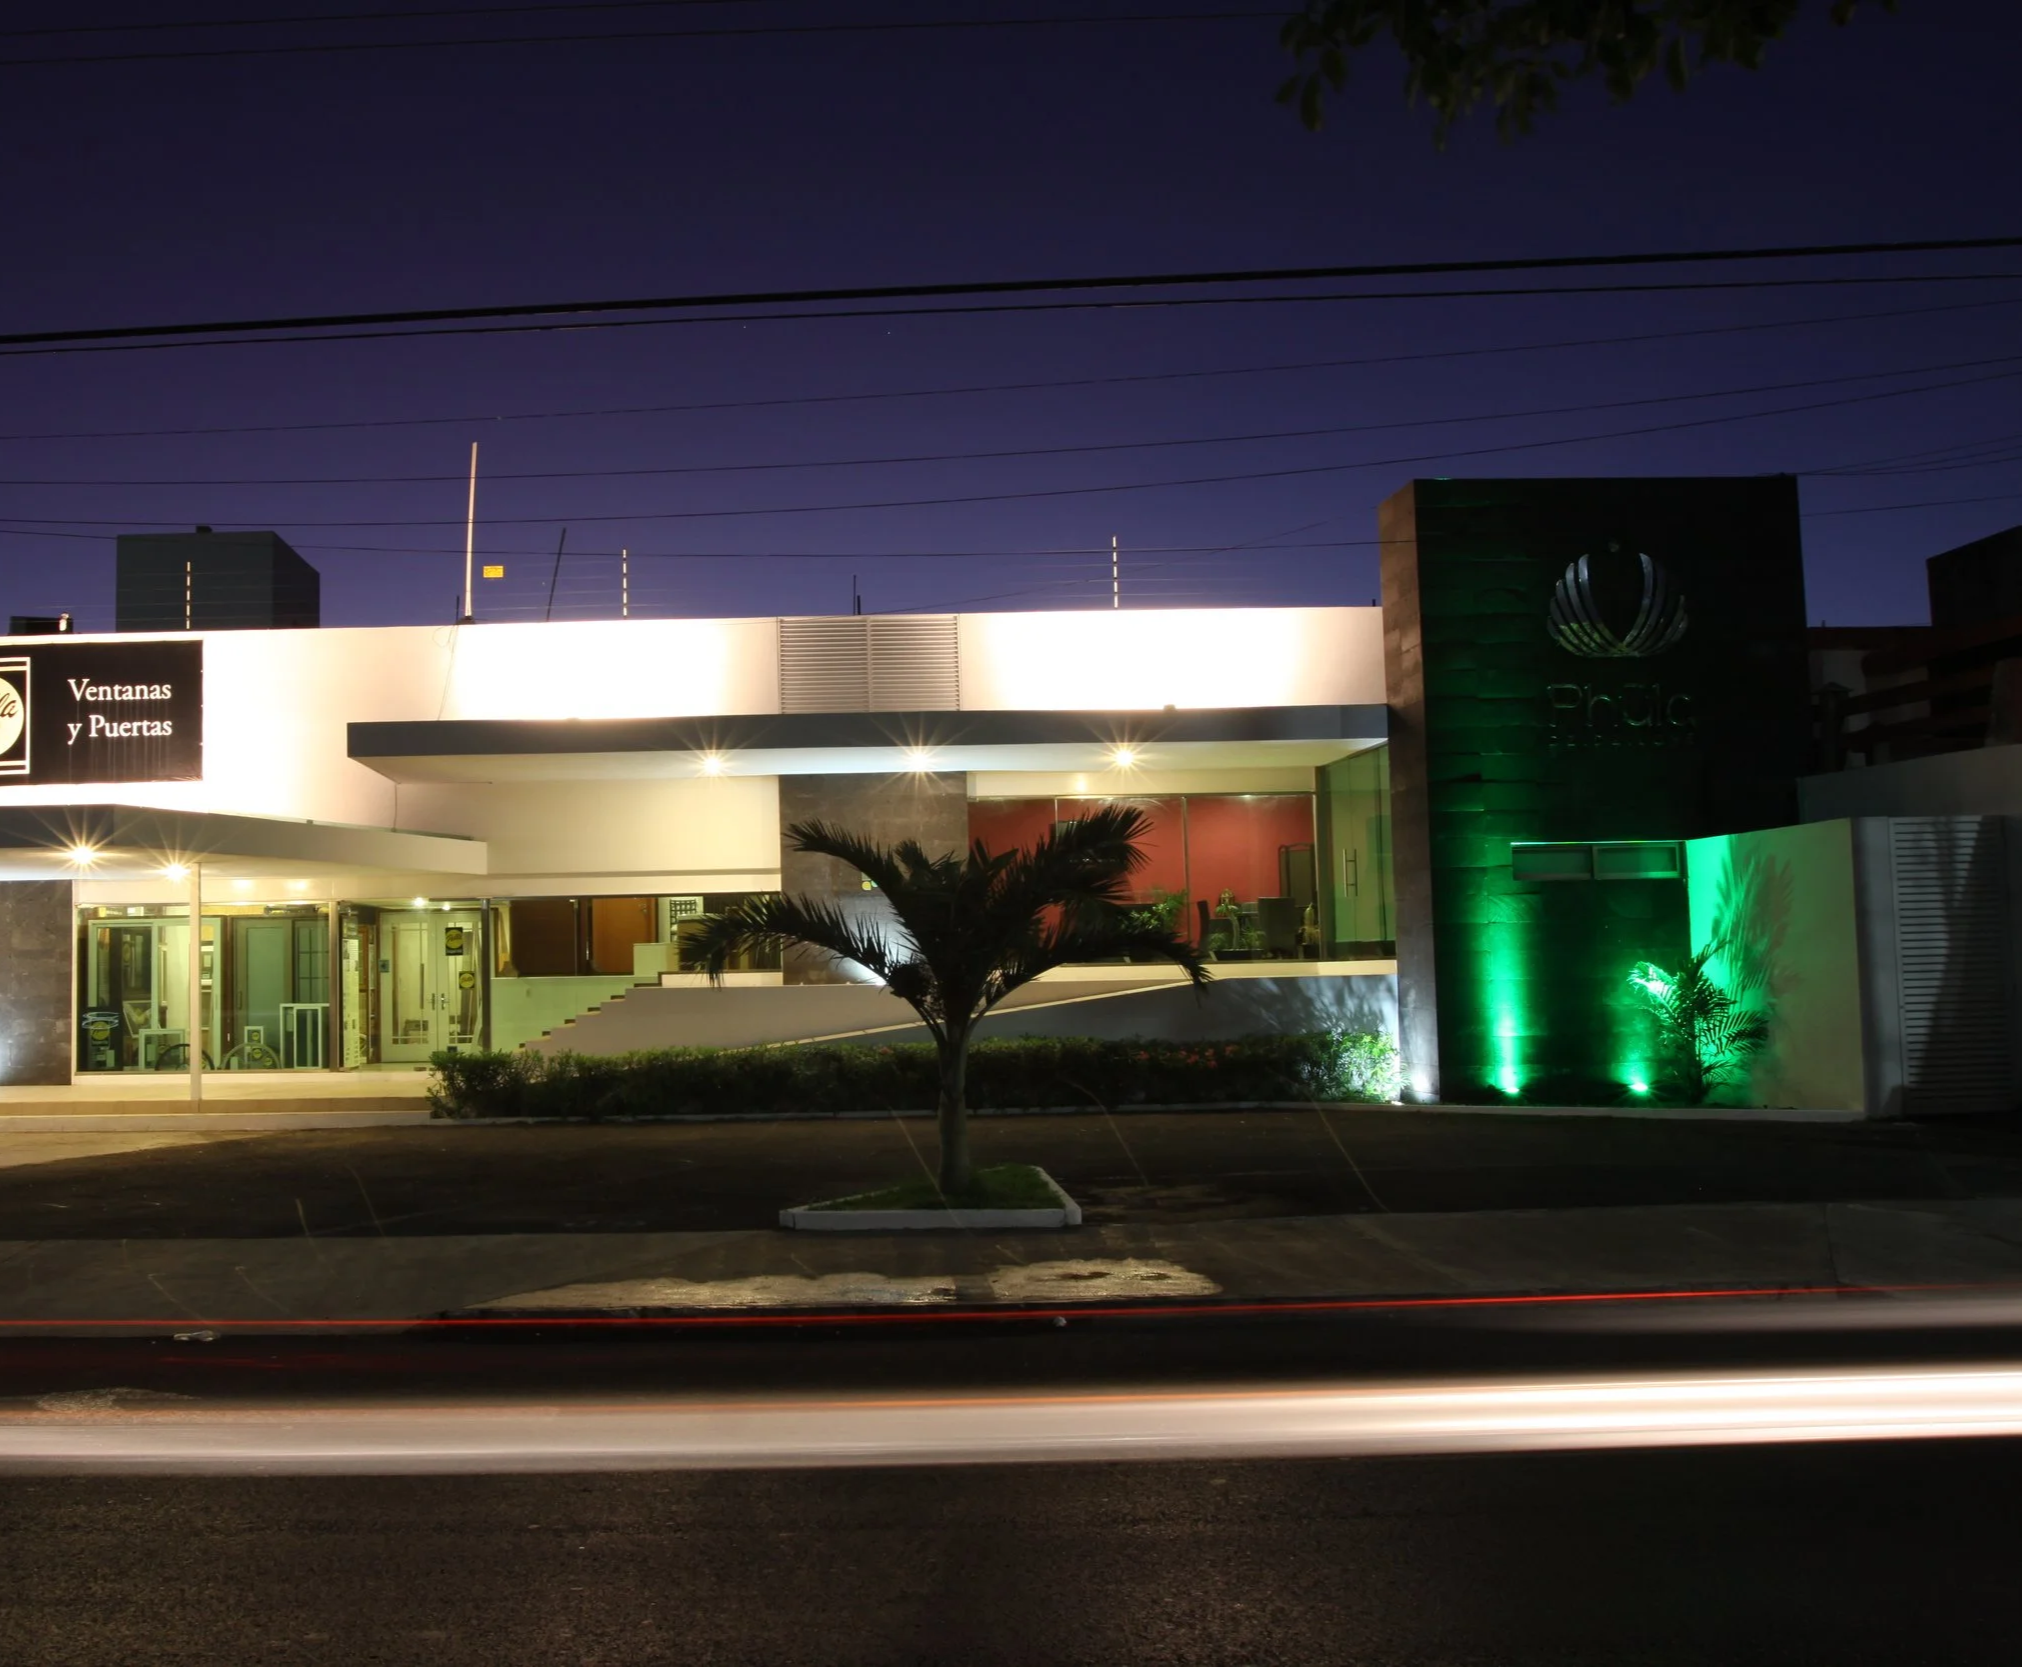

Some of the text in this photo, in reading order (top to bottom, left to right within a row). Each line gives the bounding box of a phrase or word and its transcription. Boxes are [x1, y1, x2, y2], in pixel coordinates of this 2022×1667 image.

[67, 678, 172, 701] Ventanas
[67, 714, 173, 745] y Puertas
